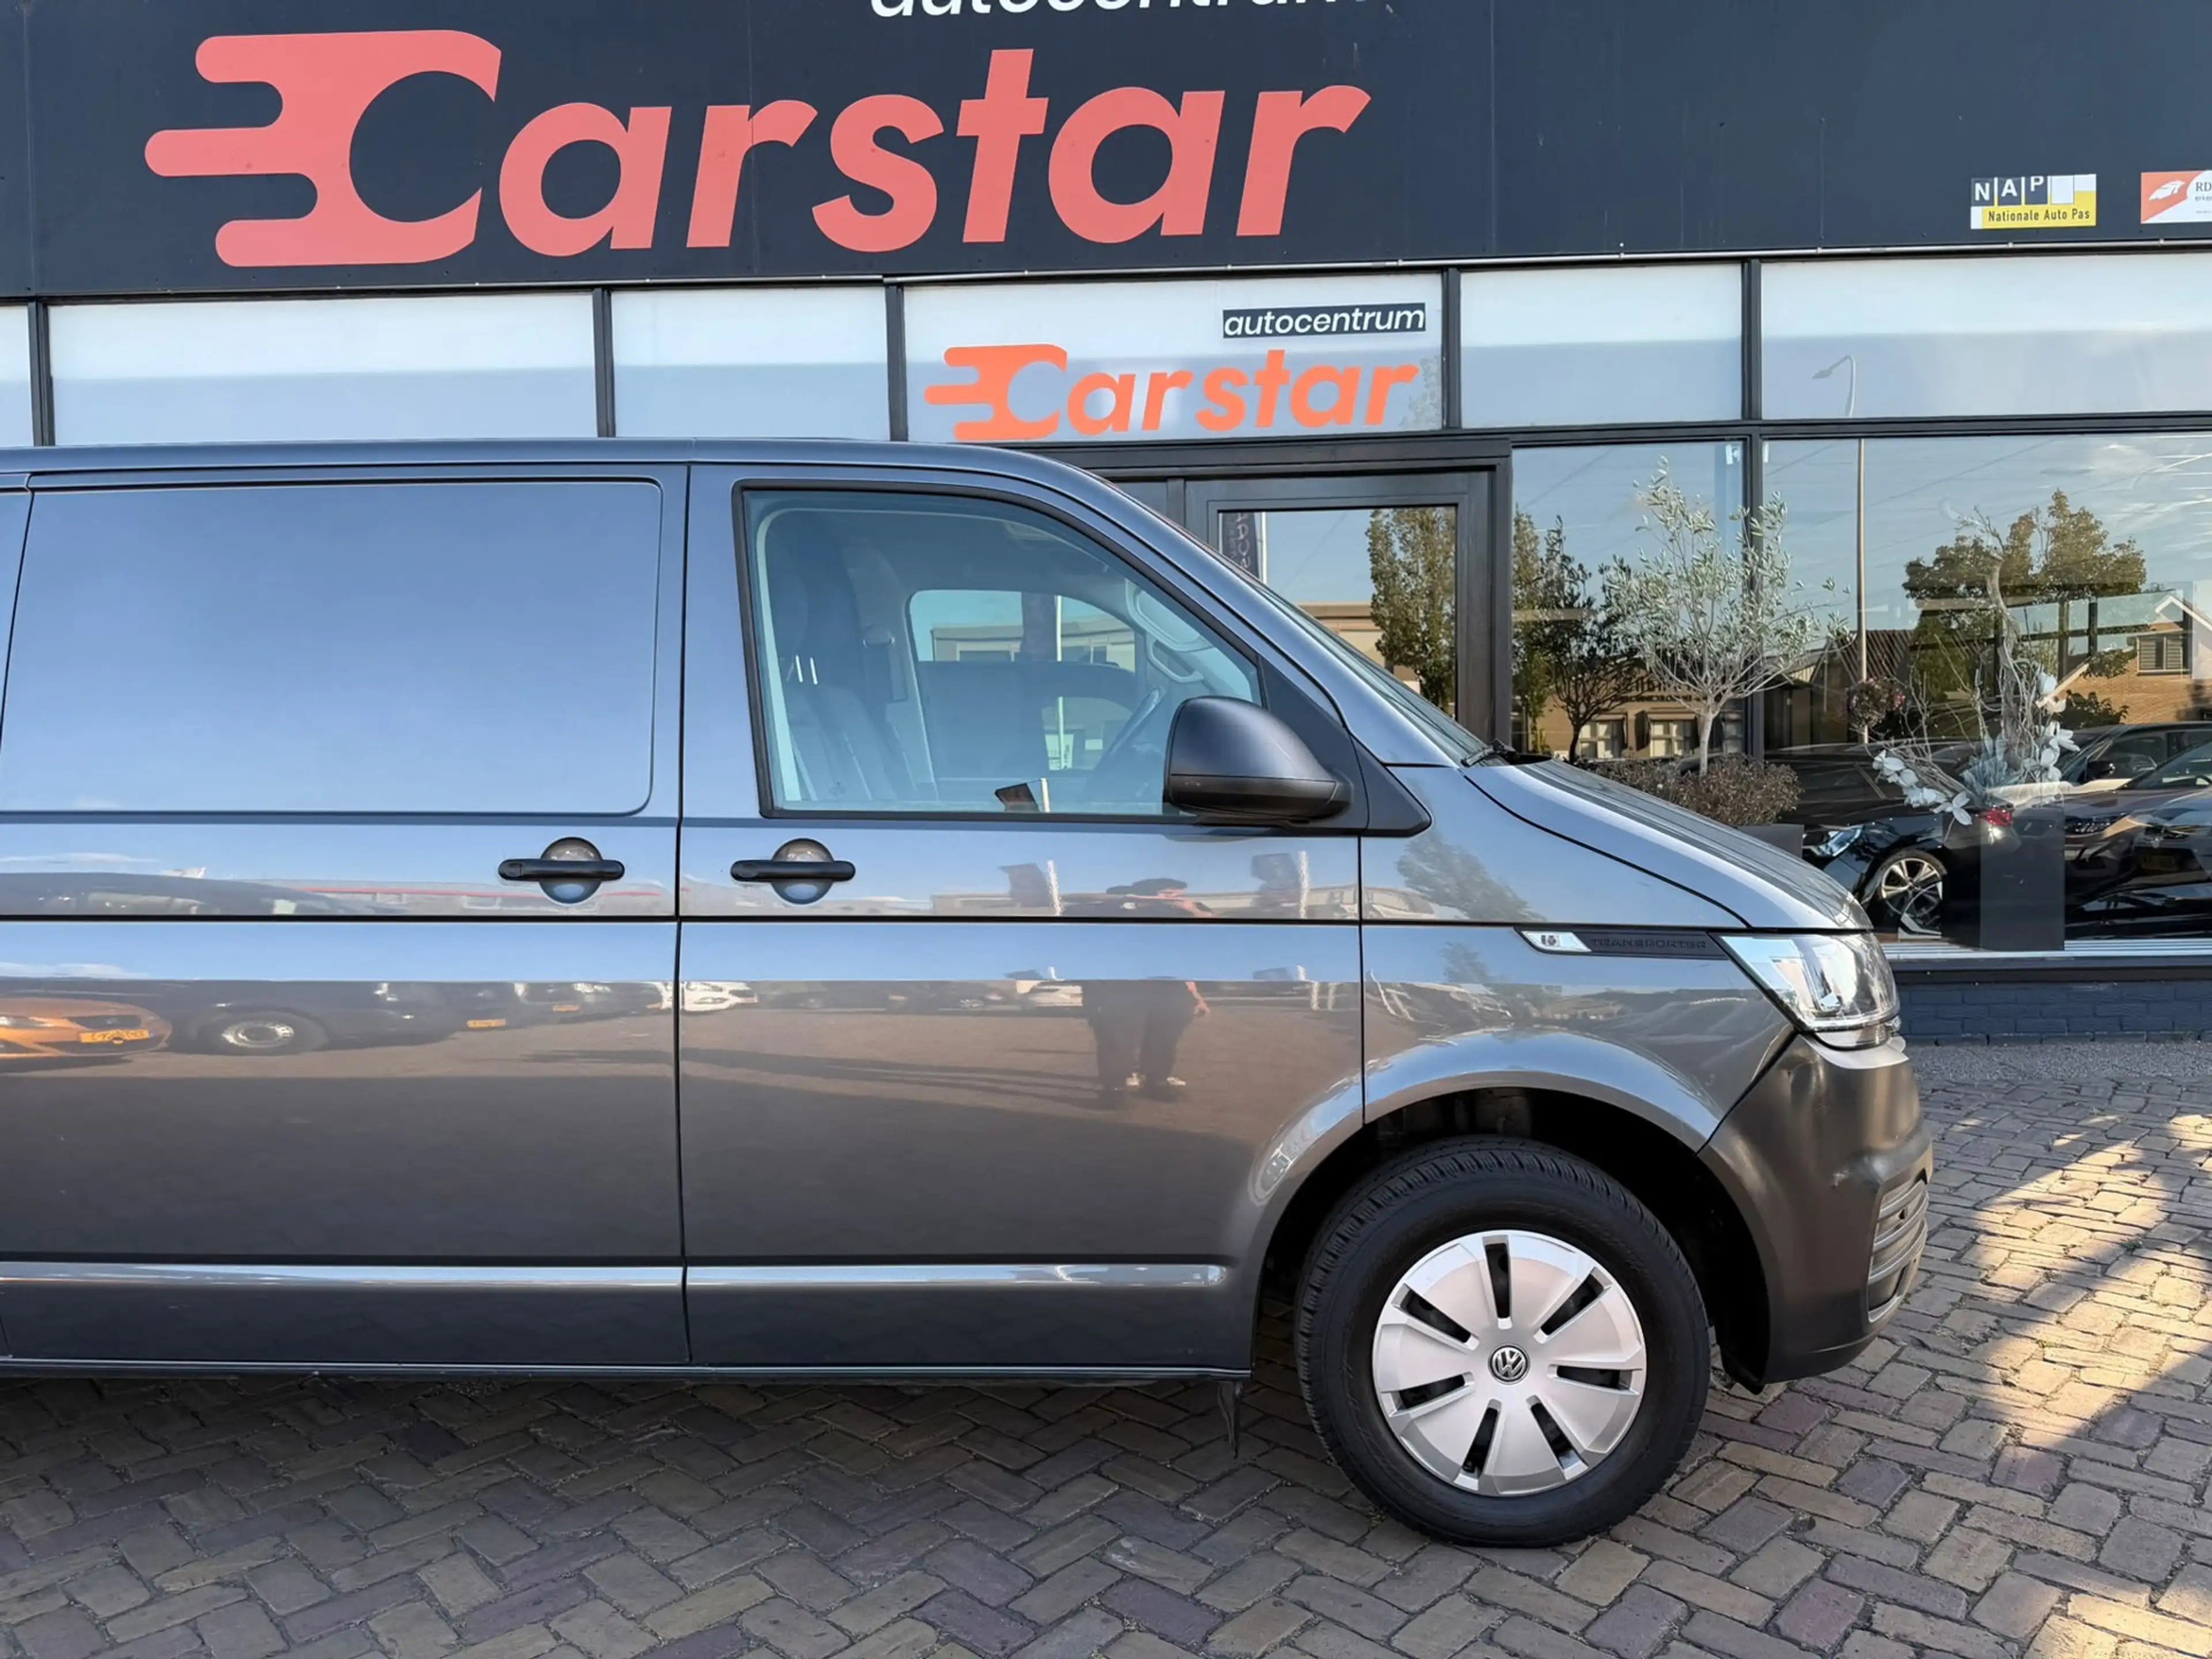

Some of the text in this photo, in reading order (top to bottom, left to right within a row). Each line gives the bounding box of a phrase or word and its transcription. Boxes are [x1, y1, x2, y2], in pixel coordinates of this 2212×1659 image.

[146, 31, 1370, 267] Carstar
[1988, 208, 2090, 222] Nationale Auto Pas
[1224, 308, 1425, 336] autocentrum
[925, 344, 1419, 441] Carstar
[1592, 938, 1707, 949] TRANSPORTER
